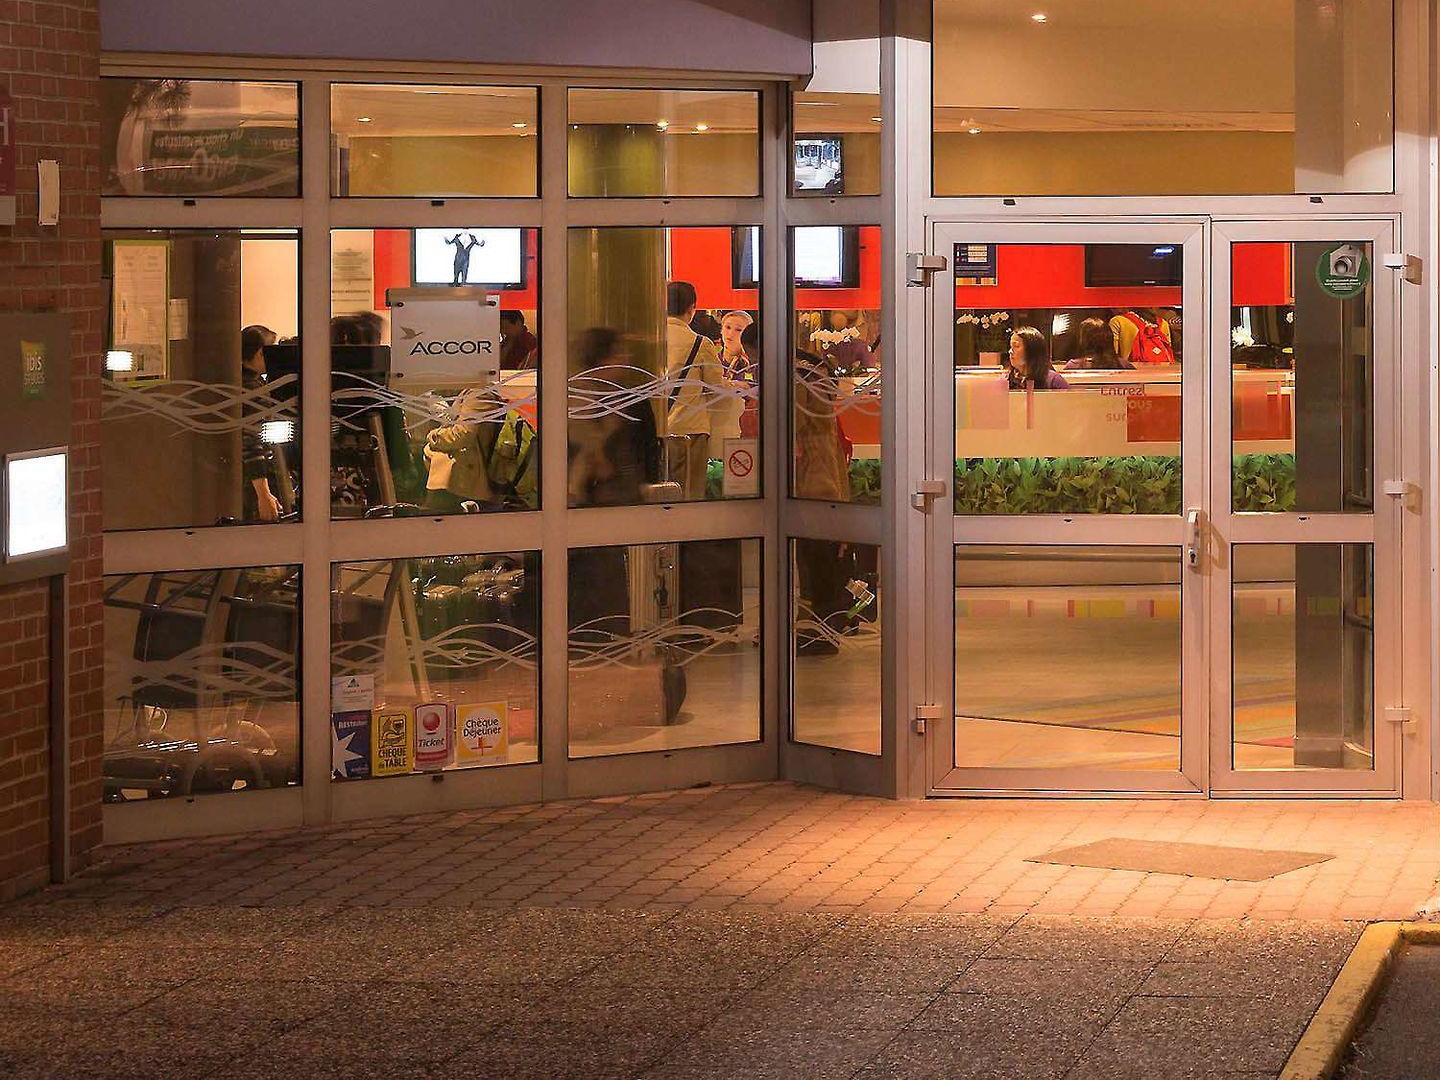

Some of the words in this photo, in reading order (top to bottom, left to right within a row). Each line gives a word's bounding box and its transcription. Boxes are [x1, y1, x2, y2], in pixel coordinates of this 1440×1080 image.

[410, 340, 492, 356] ACCOR
[418, 737, 446, 748] Ticket
[384, 757, 407, 769] TABLE
